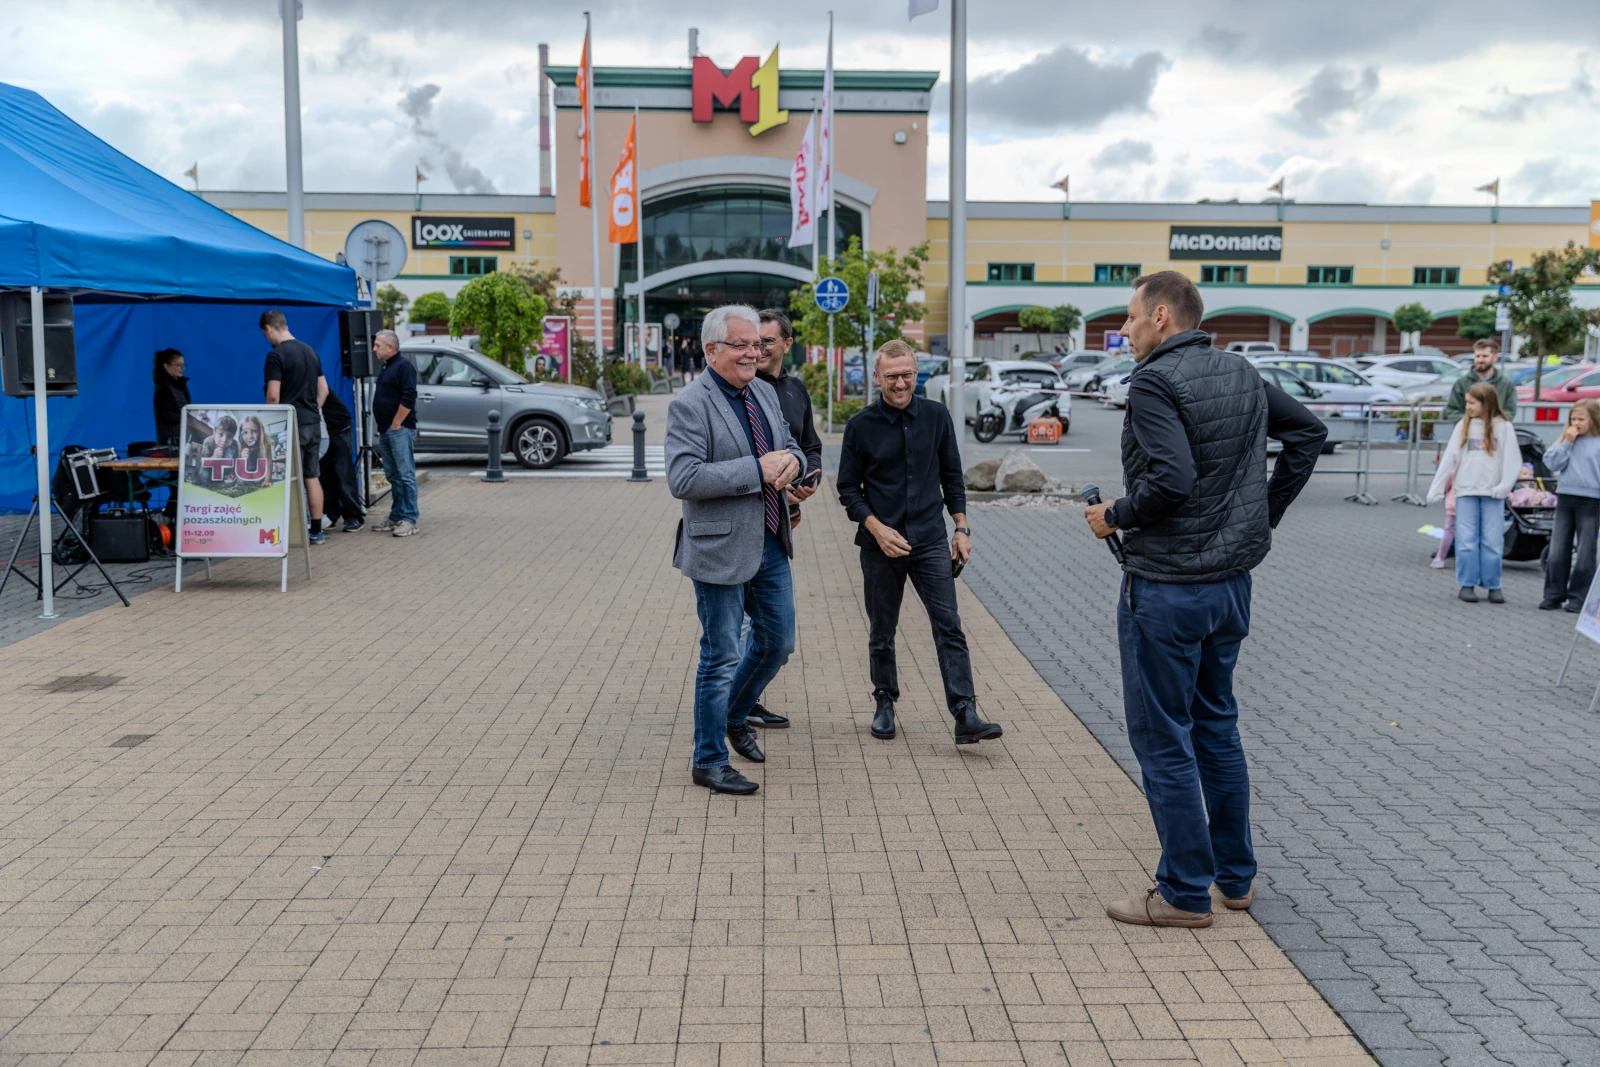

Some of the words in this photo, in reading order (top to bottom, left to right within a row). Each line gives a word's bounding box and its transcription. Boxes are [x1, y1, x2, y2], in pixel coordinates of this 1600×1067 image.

[692, 41, 788, 136] M1
[1170, 233, 1282, 251] McDonald's
[201, 458, 267, 481] TU
[184, 504, 211, 514] Targi
[213, 504, 241, 515] zajęć
[184, 516, 262, 525] pozaszkolnych
[259, 526, 281, 546] M1
